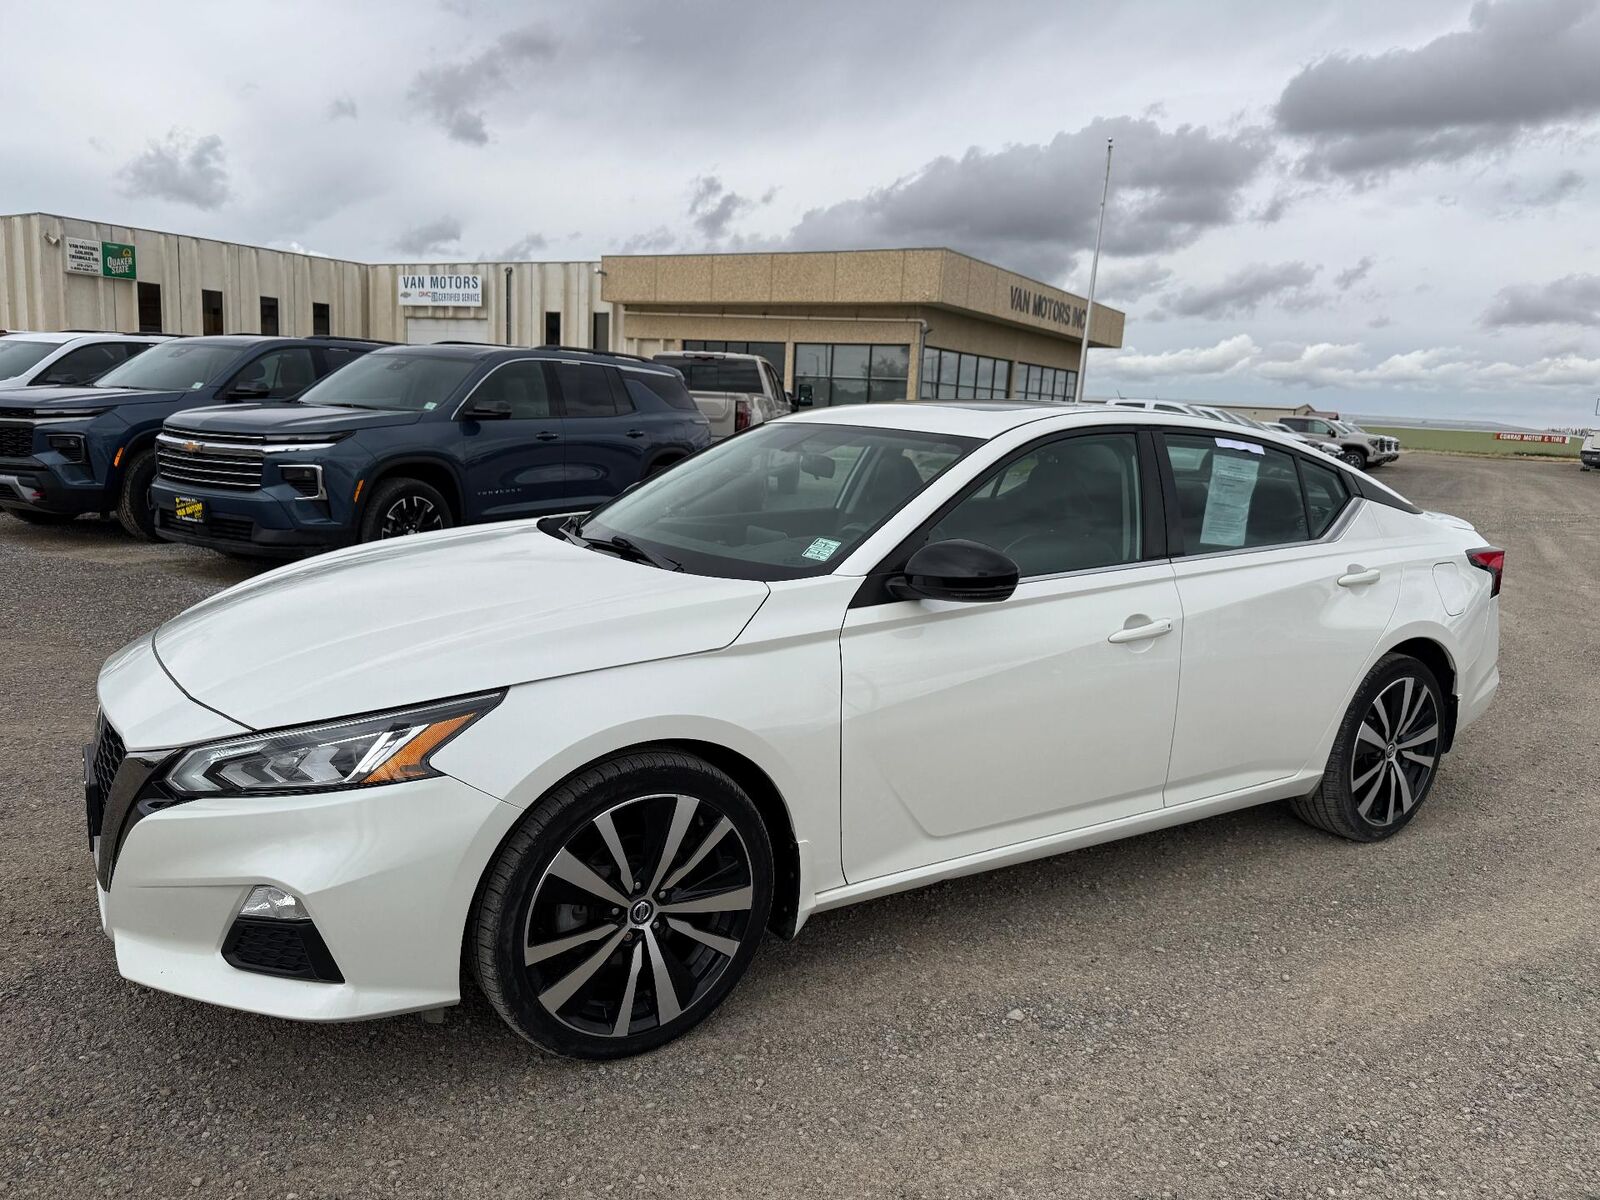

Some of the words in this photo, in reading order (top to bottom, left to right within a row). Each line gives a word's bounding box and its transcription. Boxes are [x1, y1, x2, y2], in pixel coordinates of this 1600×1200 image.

[107, 256, 132, 268] QUAKER
[112, 265, 130, 274] STATE
[402, 276, 424, 289] VAN
[430, 276, 478, 289] MOTORS
[438, 292, 460, 302] CERTIFIED
[462, 293, 480, 302] SERVICE
[1010, 285, 1031, 314] VAN
[1032, 292, 1070, 325] MOTORS
